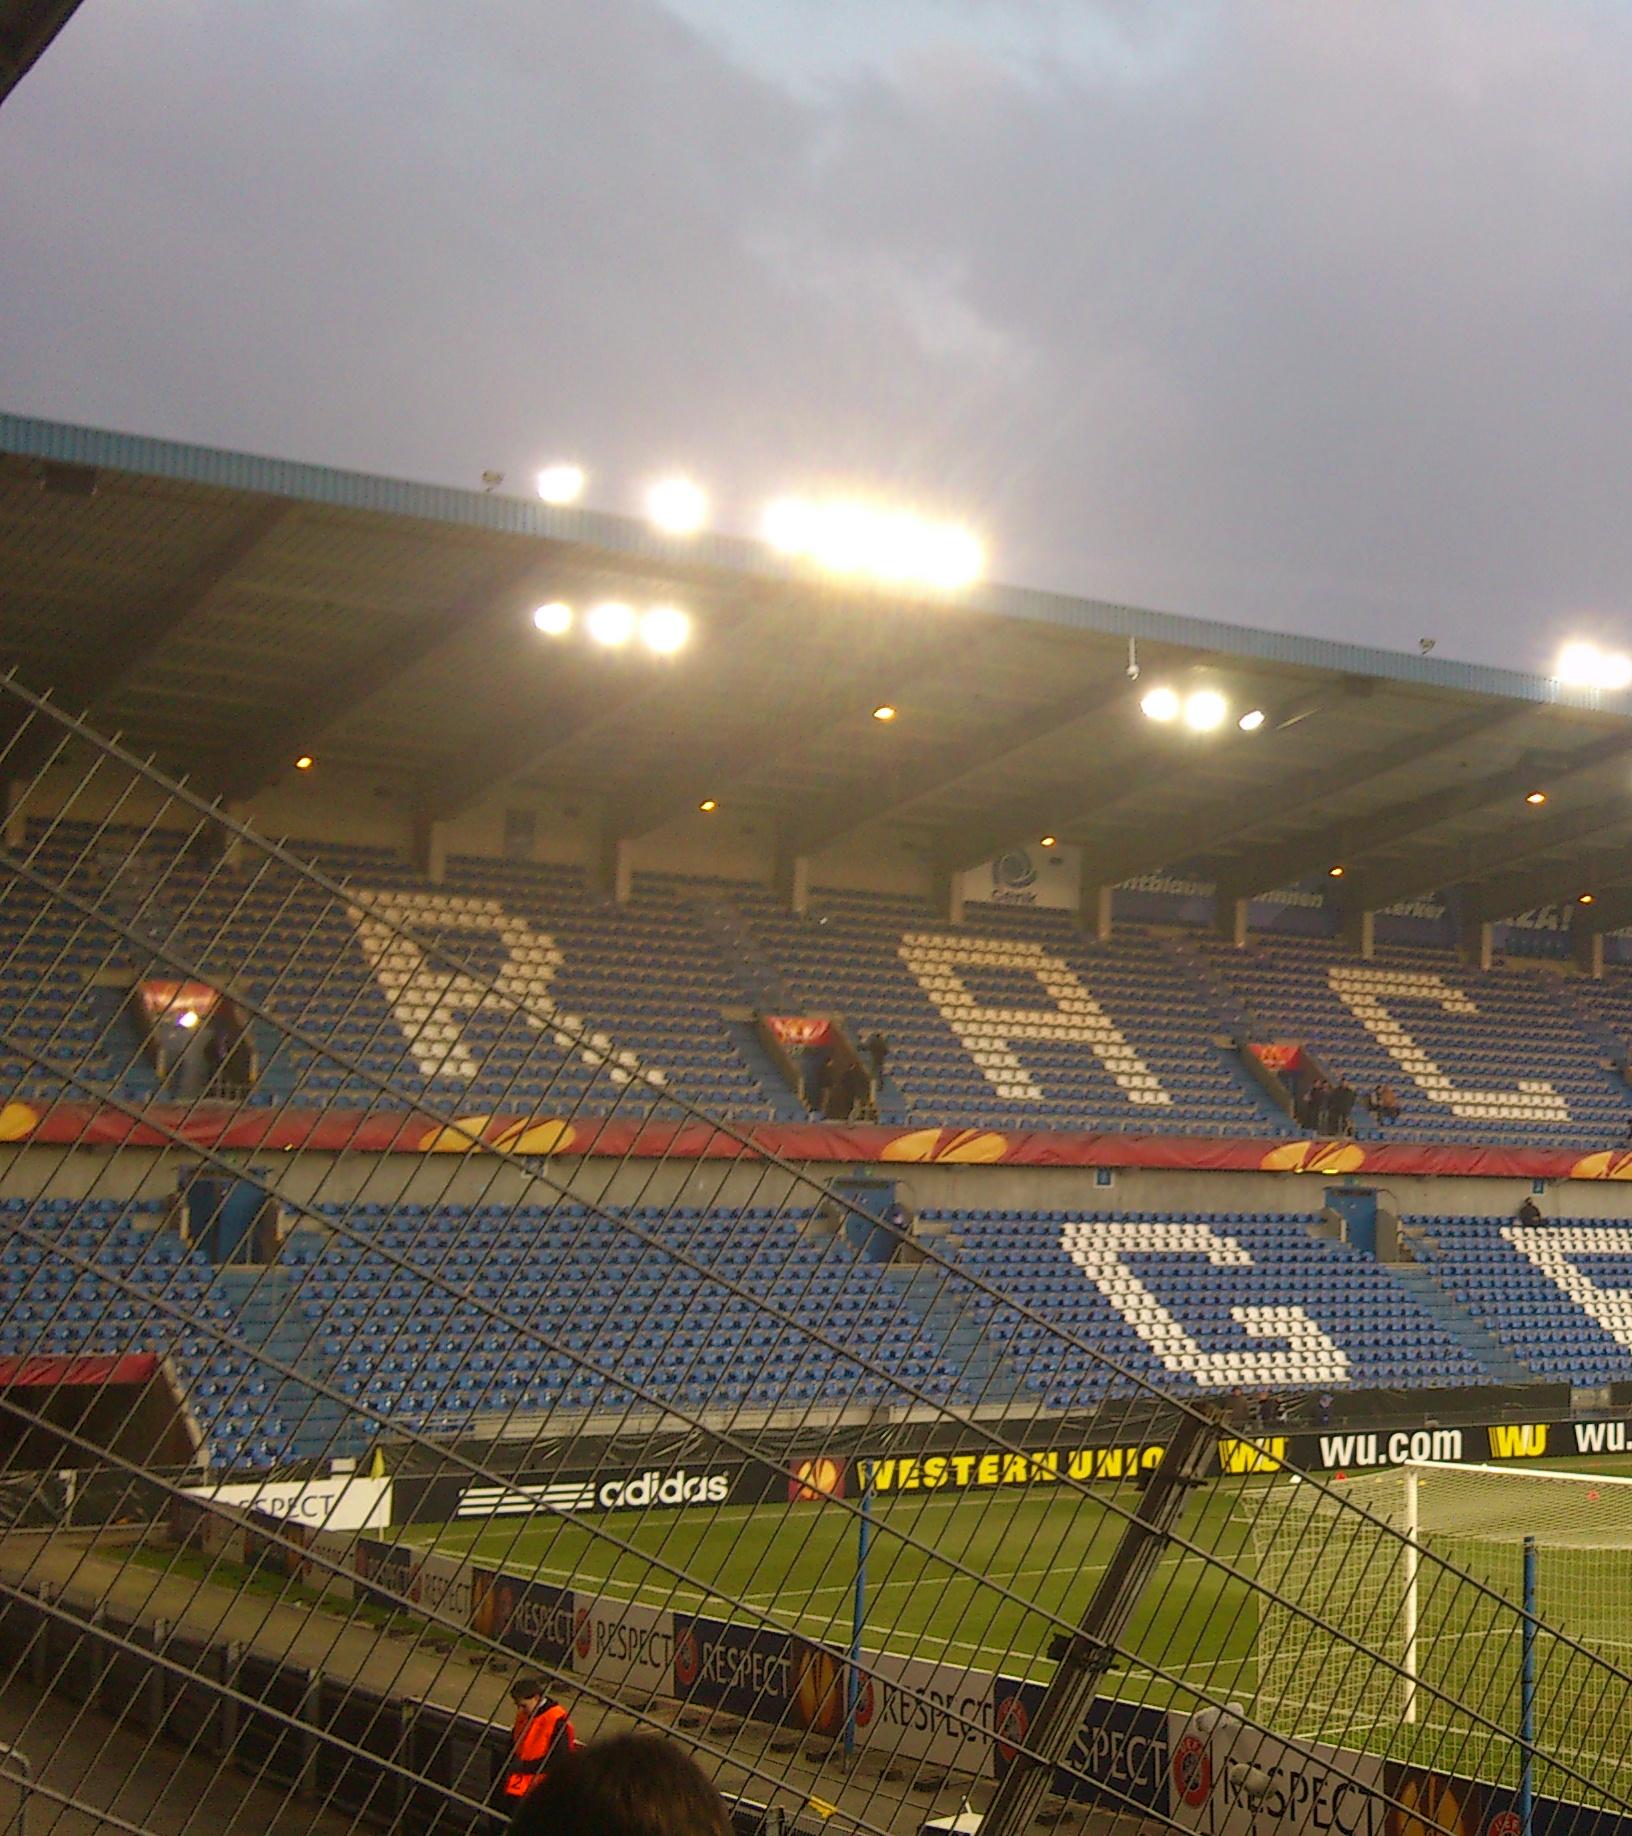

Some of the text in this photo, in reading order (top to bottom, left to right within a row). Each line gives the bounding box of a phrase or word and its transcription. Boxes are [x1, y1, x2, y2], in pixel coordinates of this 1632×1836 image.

[1218, 1436, 1288, 1474] WU
[1487, 1424, 1548, 1459] WU
[599, 1470, 731, 1508] adidas
[857, 1446, 1166, 1491] WESTERN UNIO
[513, 1602, 574, 1646] RESPECT
[596, 1621, 674, 1670] RESPECT
[702, 1641, 791, 1699] RESPECT
[882, 1681, 995, 1745] RESPECT
[1062, 1724, 1168, 1788] SPECT
